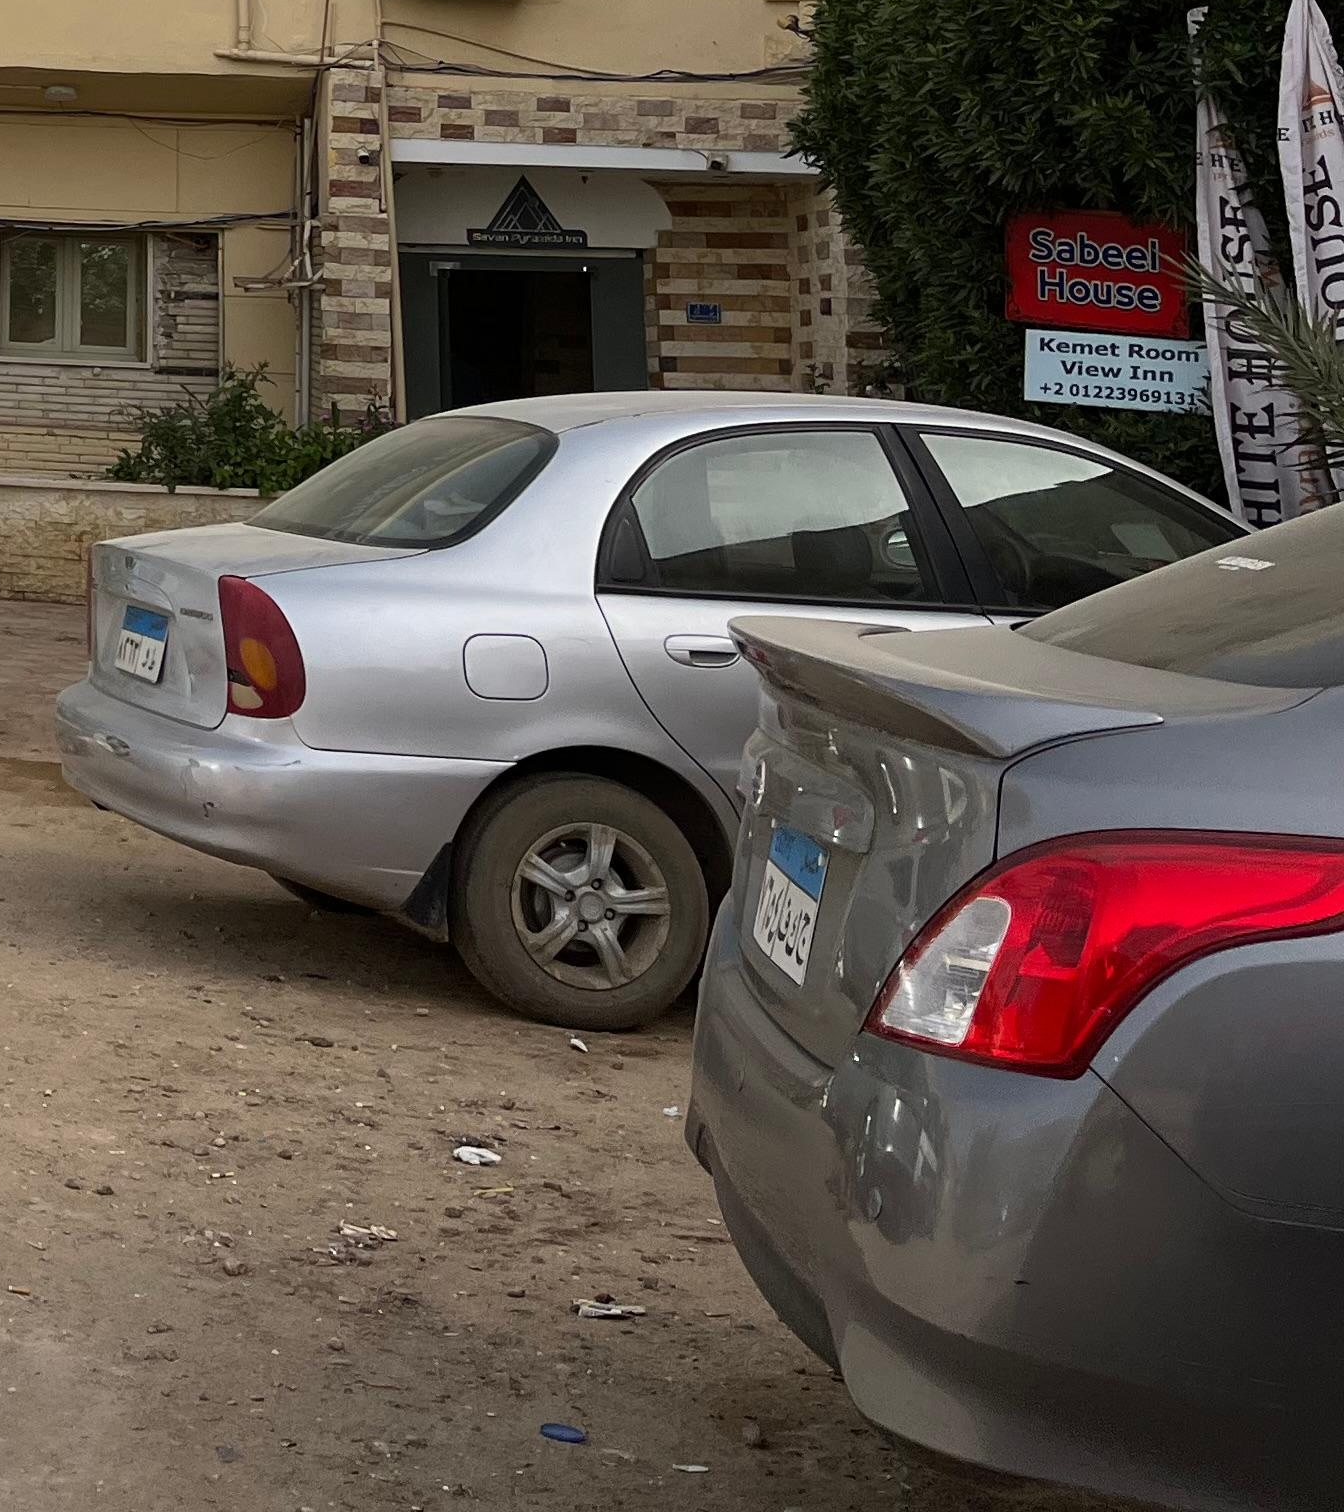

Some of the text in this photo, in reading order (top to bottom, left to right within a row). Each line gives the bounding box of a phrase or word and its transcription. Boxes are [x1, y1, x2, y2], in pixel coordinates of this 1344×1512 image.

[1028, 228, 1160, 273] Sabeel
[1036, 267, 1162, 313] House
[1039, 337, 1200, 363] Kemet Room
[1060, 360, 1175, 383] View Inn
[1040, 383, 1198, 406] +2 01223969131
